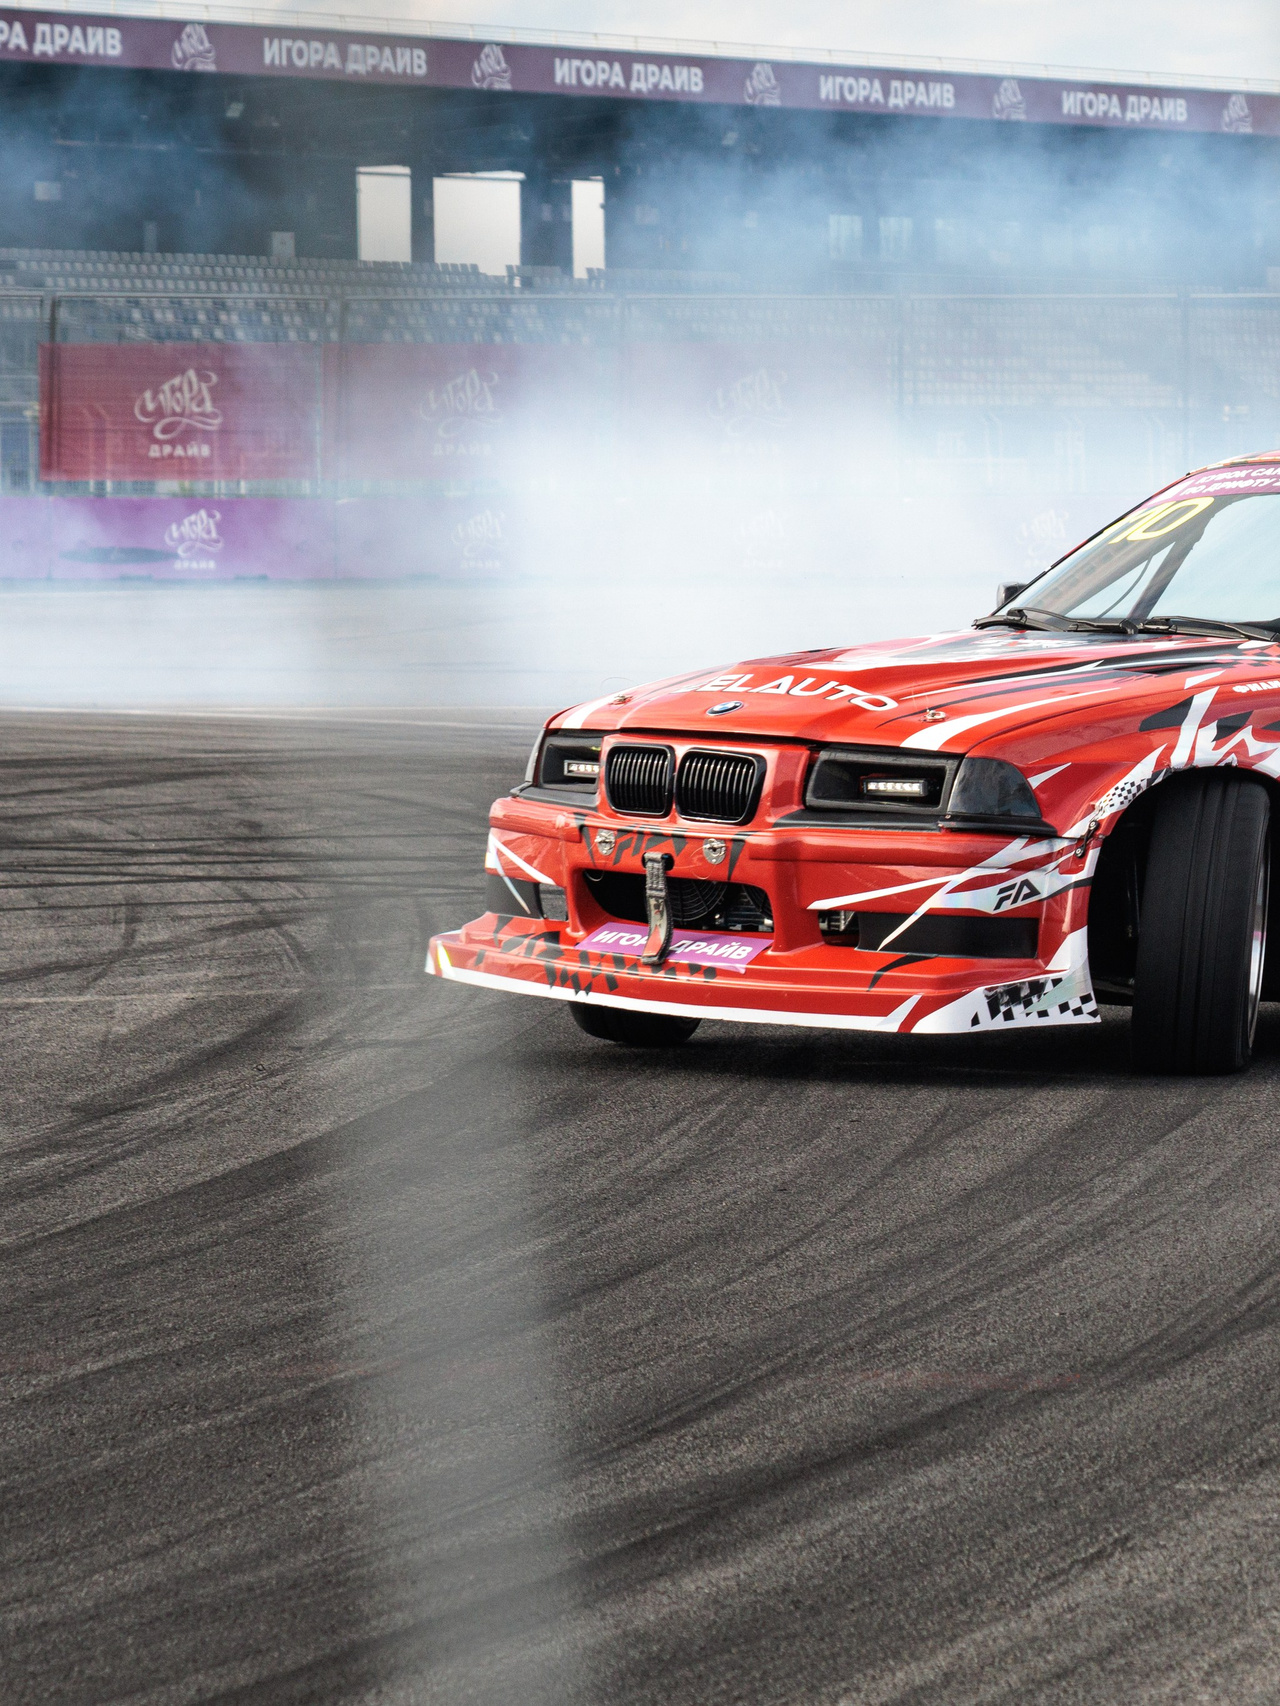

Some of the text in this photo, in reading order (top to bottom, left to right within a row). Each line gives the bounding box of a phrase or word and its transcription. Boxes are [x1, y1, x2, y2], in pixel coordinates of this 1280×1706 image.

[264, 37, 342, 69] ИГОРА
[554, 57, 626, 88] ИГОРА
[819, 75, 884, 104] ИГОРА
[1062, 90, 1122, 118] ИГОРА
[1202, 477, 1276, 494] ДРИФТУ
[993, 878, 1041, 911] FA
[592, 930, 754, 961] ИГОР ДРАЙВ
